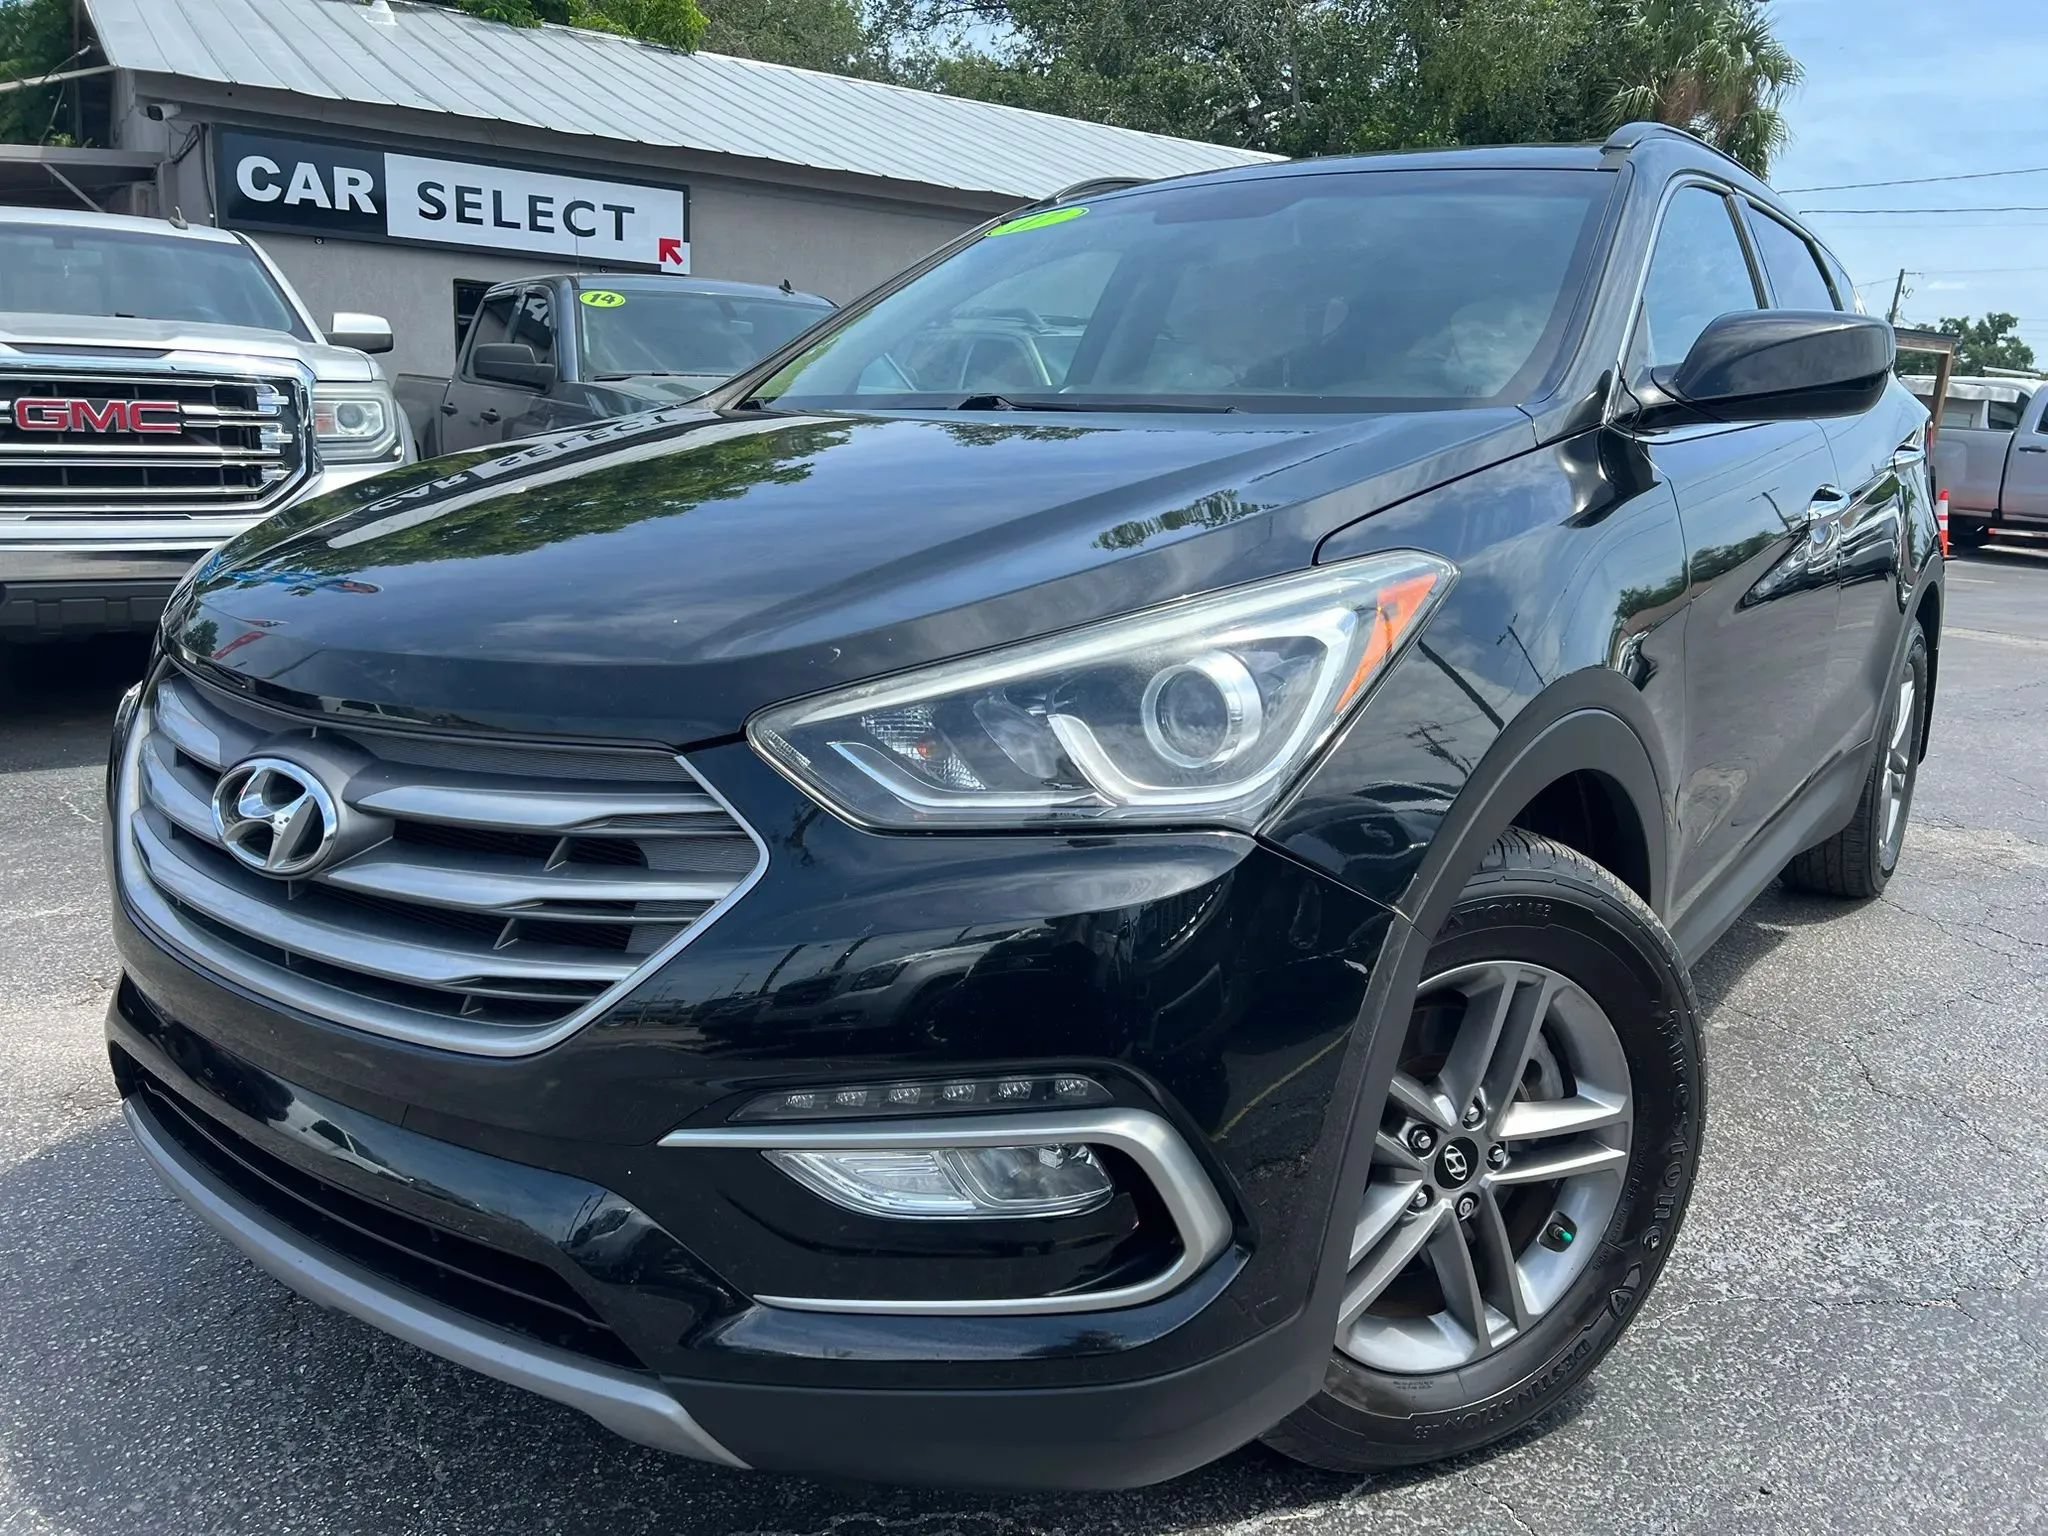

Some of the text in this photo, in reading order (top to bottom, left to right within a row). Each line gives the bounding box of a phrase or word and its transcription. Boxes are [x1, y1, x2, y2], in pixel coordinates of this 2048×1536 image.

[236, 154, 635, 241] CAR SELECT
[589, 293, 616, 305] 14
[13, 397, 183, 434] GMC
[1642, 1008, 1692, 1253] Firestone
[1441, 1338, 1594, 1434] DESTINATION
